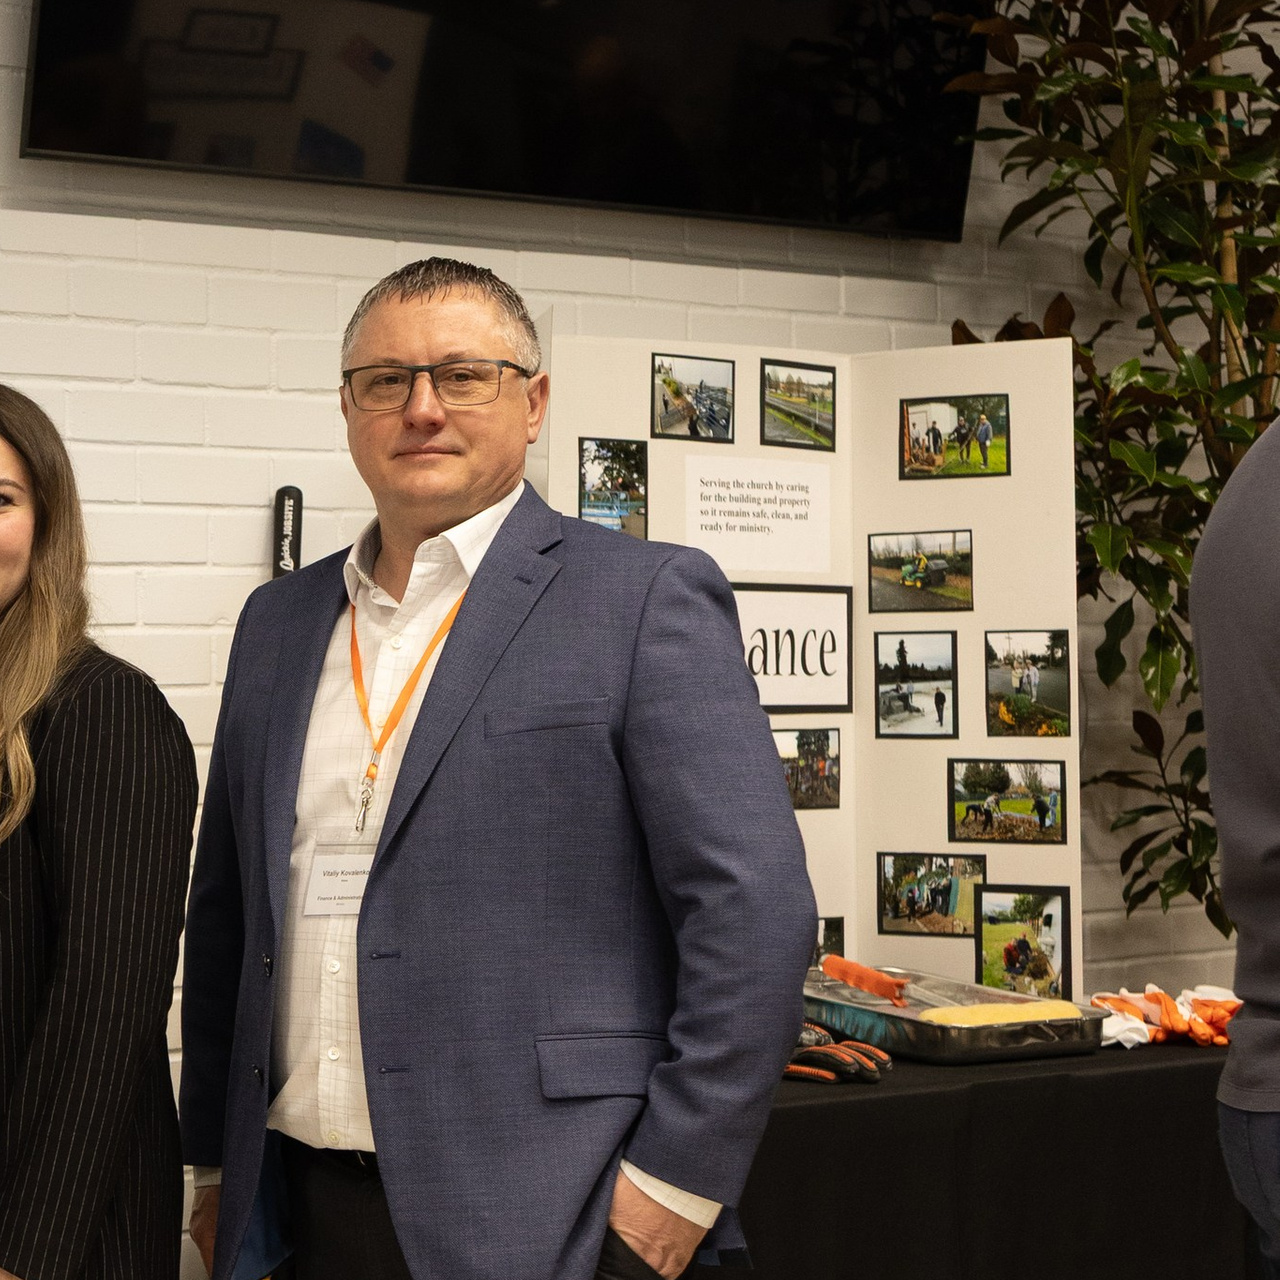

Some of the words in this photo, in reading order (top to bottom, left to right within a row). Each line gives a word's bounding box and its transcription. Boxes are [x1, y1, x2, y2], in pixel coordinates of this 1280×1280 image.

[700, 478, 730, 490] Serving
[732, 479, 745, 489] the
[746, 480, 774, 490] church
[775, 482, 784, 492] by
[786, 483, 809, 494] caring
[700, 492, 711, 502] for
[714, 493, 727, 502] the
[728, 494, 761, 505] building
[763, 496, 777, 505] and
[779, 497, 810, 509] property
[283, 498, 294, 535] JOBSITE
[711, 507, 717, 516] it
[719, 508, 750, 518] remains
[752, 510, 770, 520] safe,
[771, 510, 792, 520] clean,
[794, 511, 808, 520] and
[700, 522, 722, 534] ready
[725, 522, 737, 532] for
[739, 523, 774, 535] ministry.
[280, 536, 294, 572] Quickie
[748, 628, 837, 676] ance
